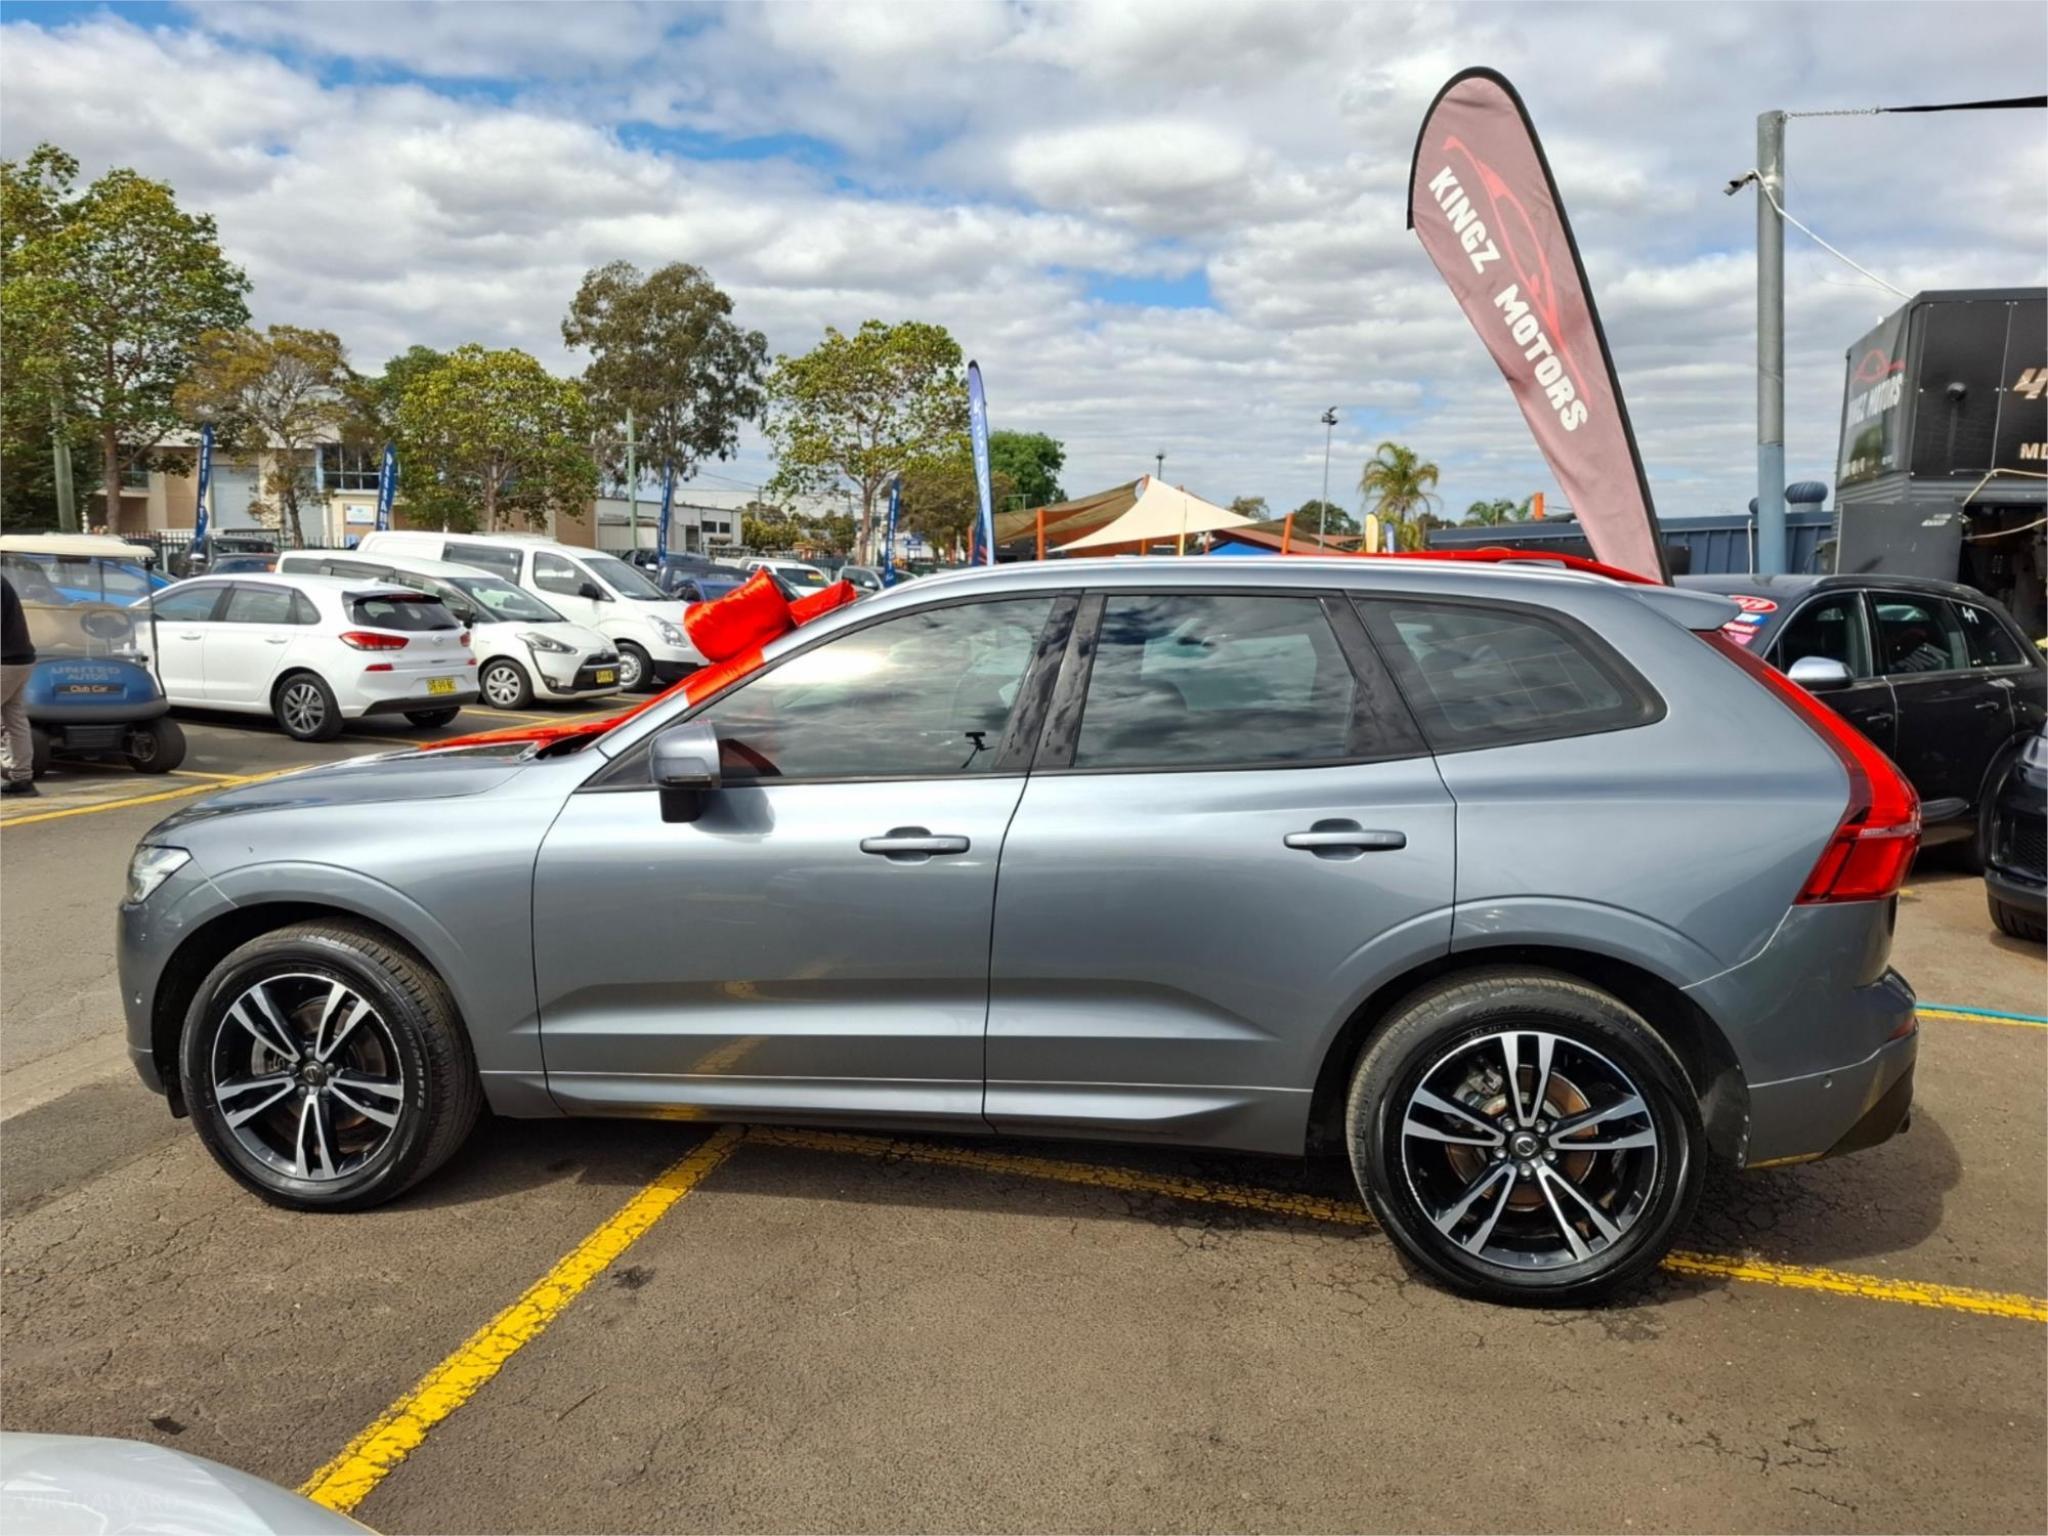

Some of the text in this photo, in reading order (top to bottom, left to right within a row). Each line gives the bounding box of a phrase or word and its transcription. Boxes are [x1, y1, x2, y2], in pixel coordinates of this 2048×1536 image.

[1428, 166, 1588, 432] KINGZ MOTORS
[50, 666, 120, 675] UNITED
[69, 685, 109, 693] Club Car
